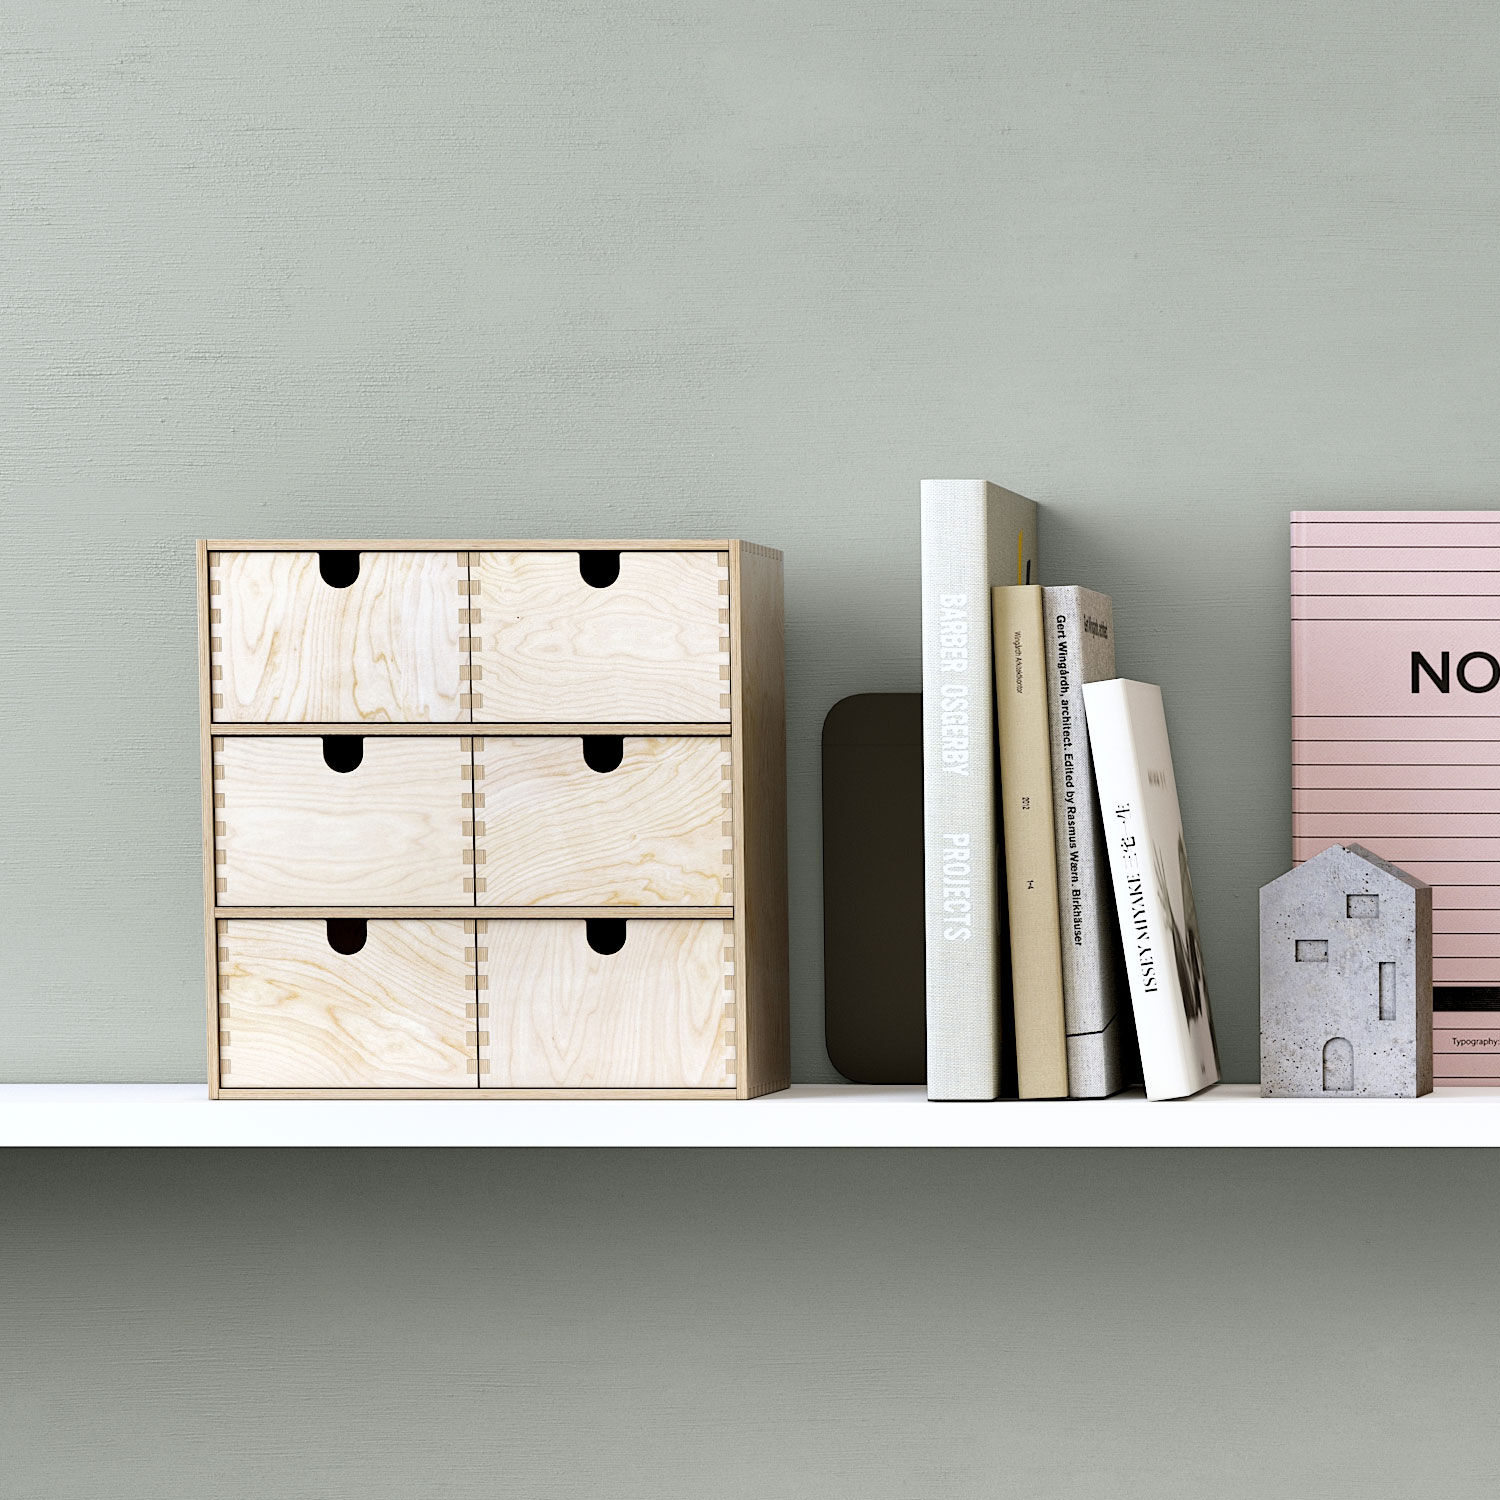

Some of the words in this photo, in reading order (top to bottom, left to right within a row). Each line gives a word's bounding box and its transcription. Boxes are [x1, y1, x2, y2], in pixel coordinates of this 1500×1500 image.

[940, 594, 968, 672] BARBER
[1056, 614, 1066, 639] Gert
[941, 685, 969, 777] OSGERBY
[1061, 699, 1073, 751] architect.
[1064, 753, 1075, 788] Edited
[1022, 796, 1030, 810] 2012
[1064, 791, 1075, 804] by
[1067, 806, 1077, 849] Rasmus
[942, 833, 971, 941] PROJECTS
[1127, 873, 1150, 940] MIYAKE
[1071, 889, 1082, 946] Birkhäuser
[1137, 944, 1158, 992] ISSEY
[1451, 1037, 1500, 1047] Typography:
